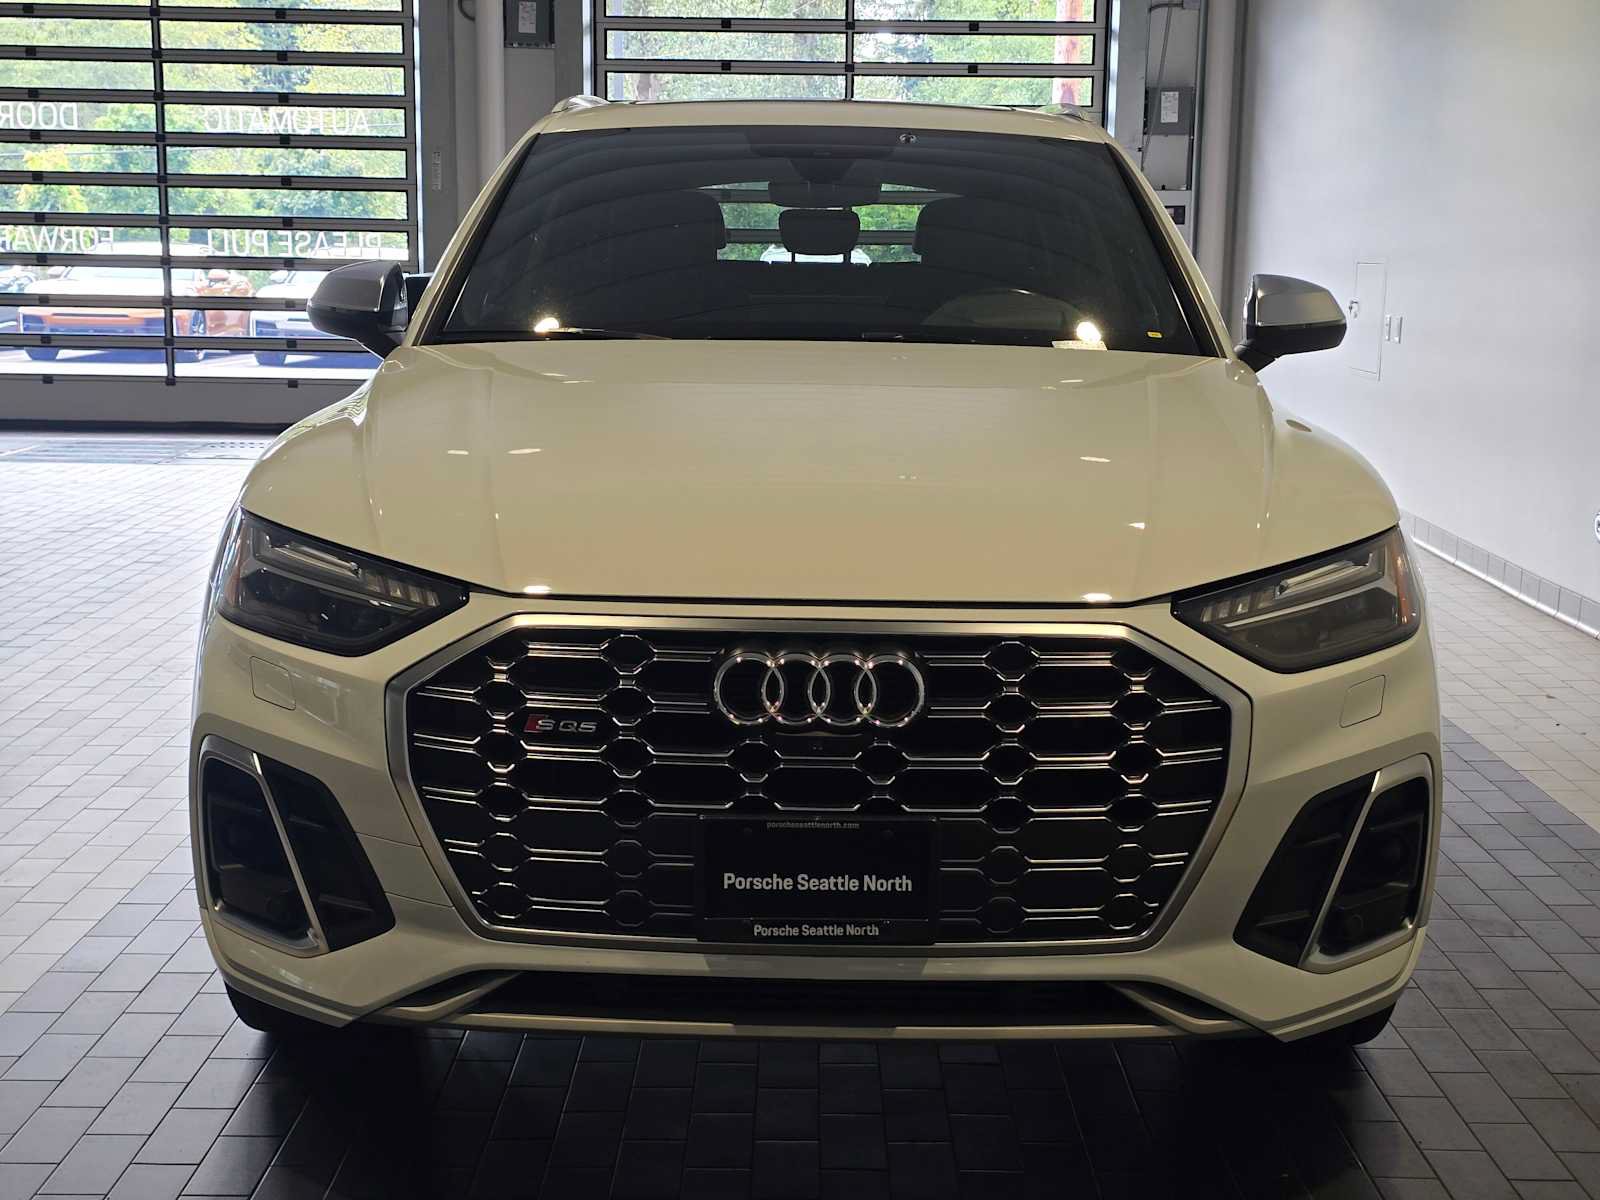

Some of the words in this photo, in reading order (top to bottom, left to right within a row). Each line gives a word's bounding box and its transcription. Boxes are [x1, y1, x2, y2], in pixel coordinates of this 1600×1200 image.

[723, 872, 794, 890] Porsche
[797, 874, 860, 891] Seattle
[863, 875, 913, 892] North
[753, 924, 799, 936] Porsche
[801, 924, 844, 936] Seattle
[845, 924, 880, 936] North
